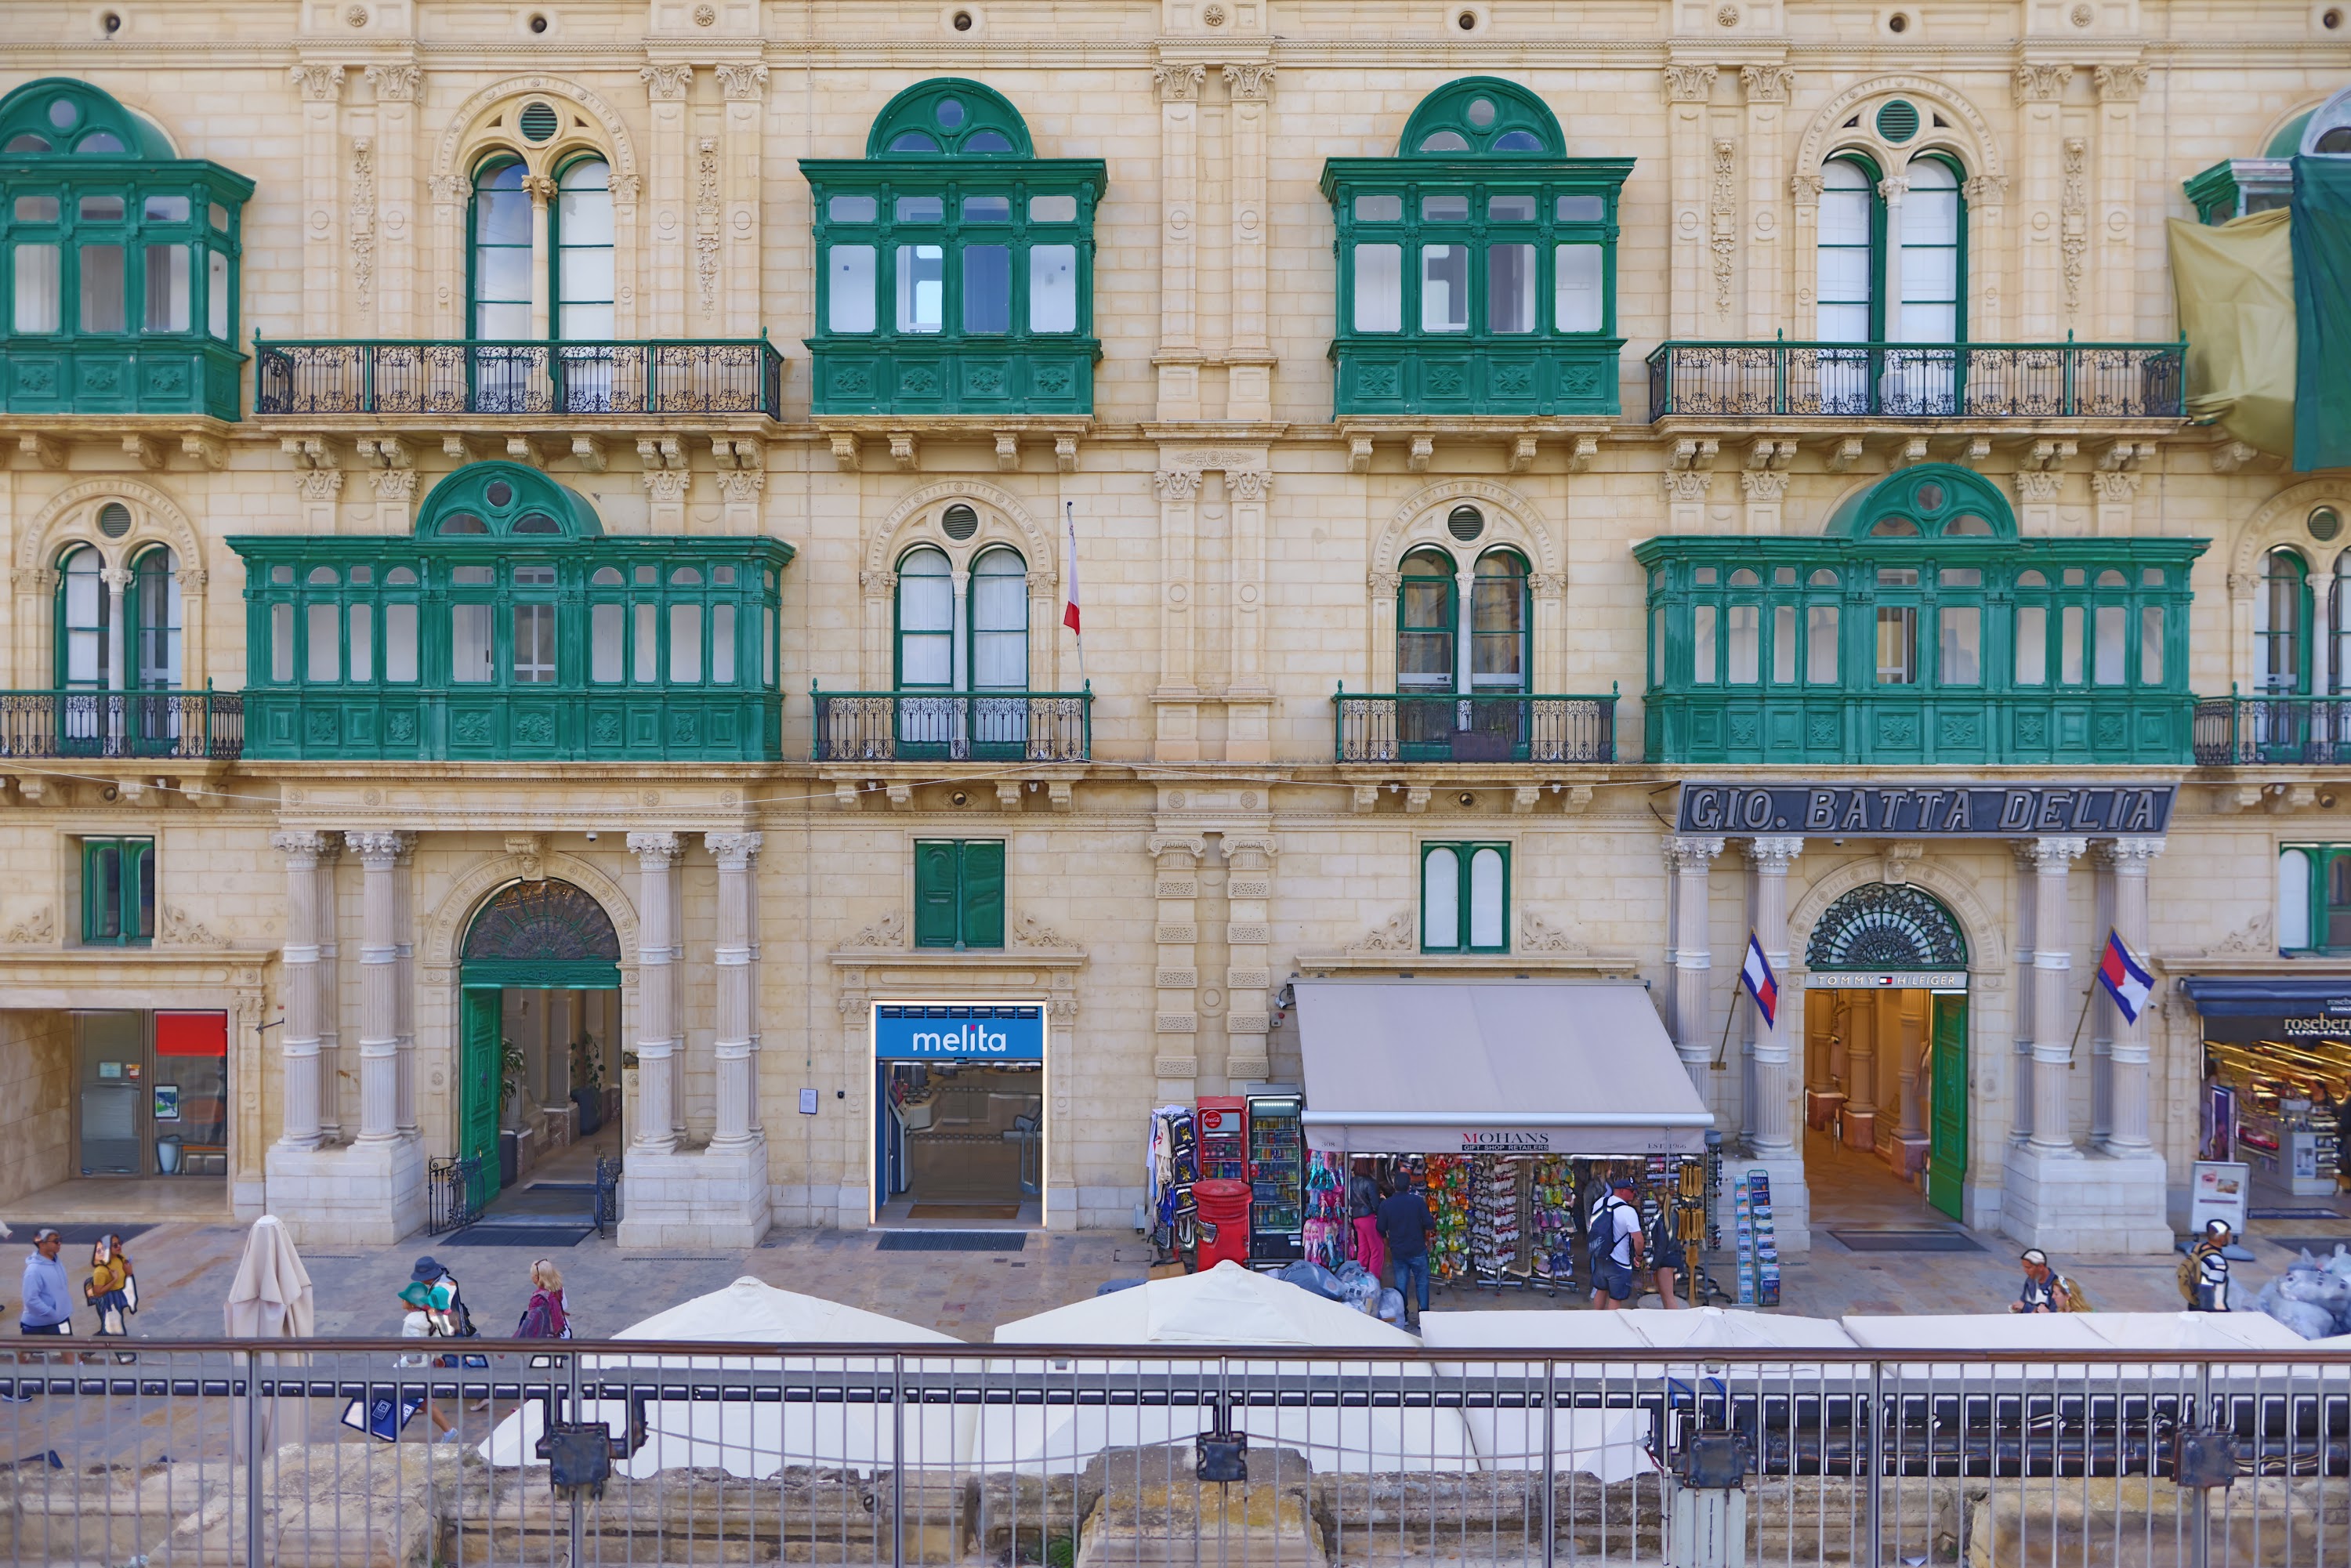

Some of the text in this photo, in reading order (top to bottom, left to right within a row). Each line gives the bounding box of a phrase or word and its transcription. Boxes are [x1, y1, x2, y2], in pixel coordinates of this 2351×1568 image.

[1691, 788, 2156, 829] GIO. BATTA DELIA
[1817, 976, 1954, 985] TOMMY HILFIGER
[913, 1024, 1006, 1052] melita
[1462, 1132, 1549, 1143] MOHANS
